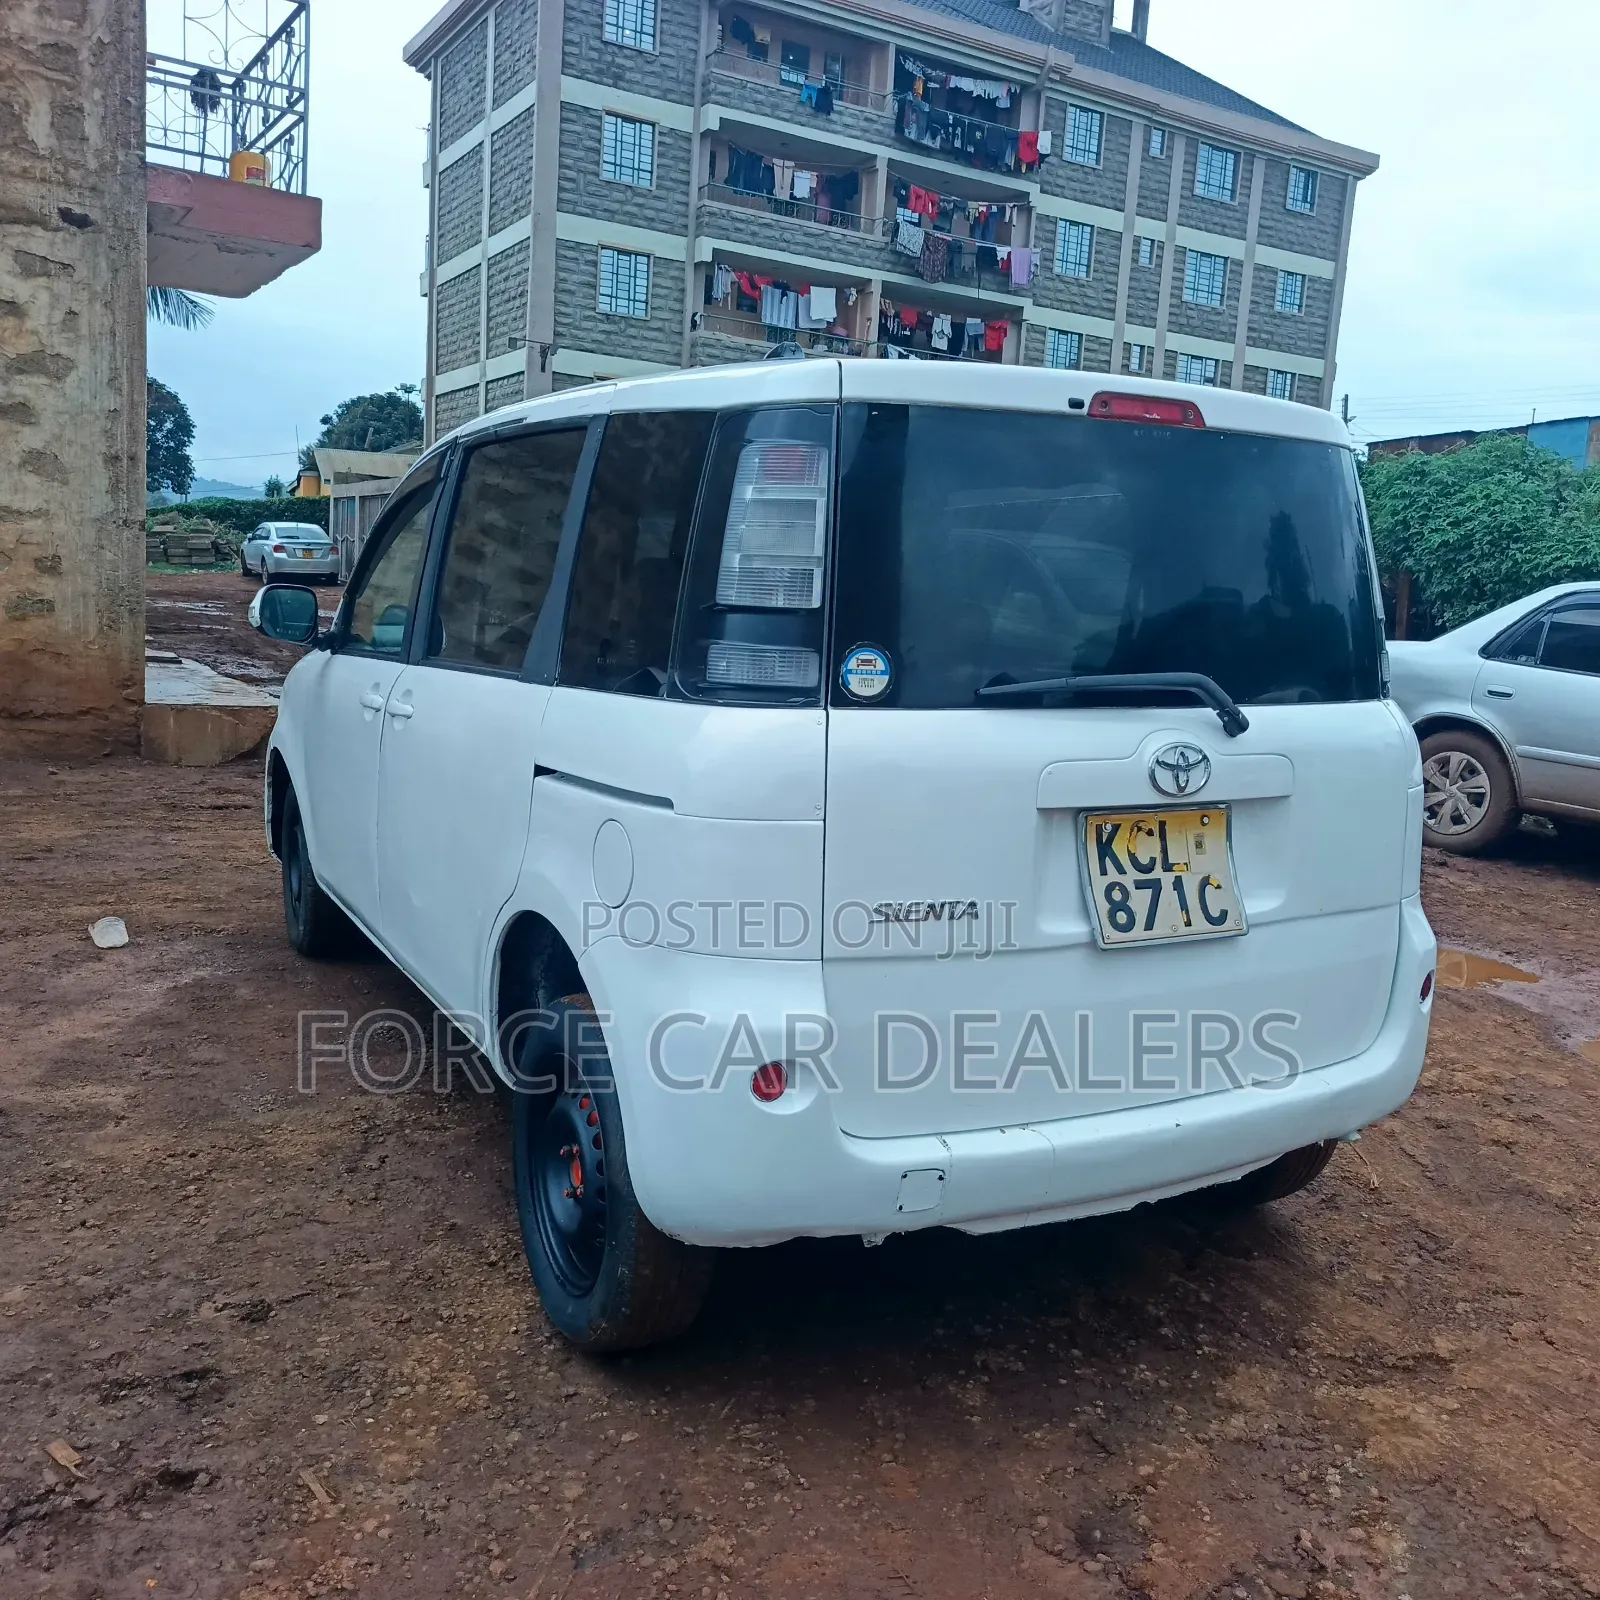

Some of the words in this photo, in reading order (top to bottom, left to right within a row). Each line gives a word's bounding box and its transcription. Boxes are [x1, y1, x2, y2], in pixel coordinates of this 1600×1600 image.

[1095, 819, 1189, 876] KCL
[869, 898, 979, 923] SIENTA
[1104, 874, 1229, 933] 871C
